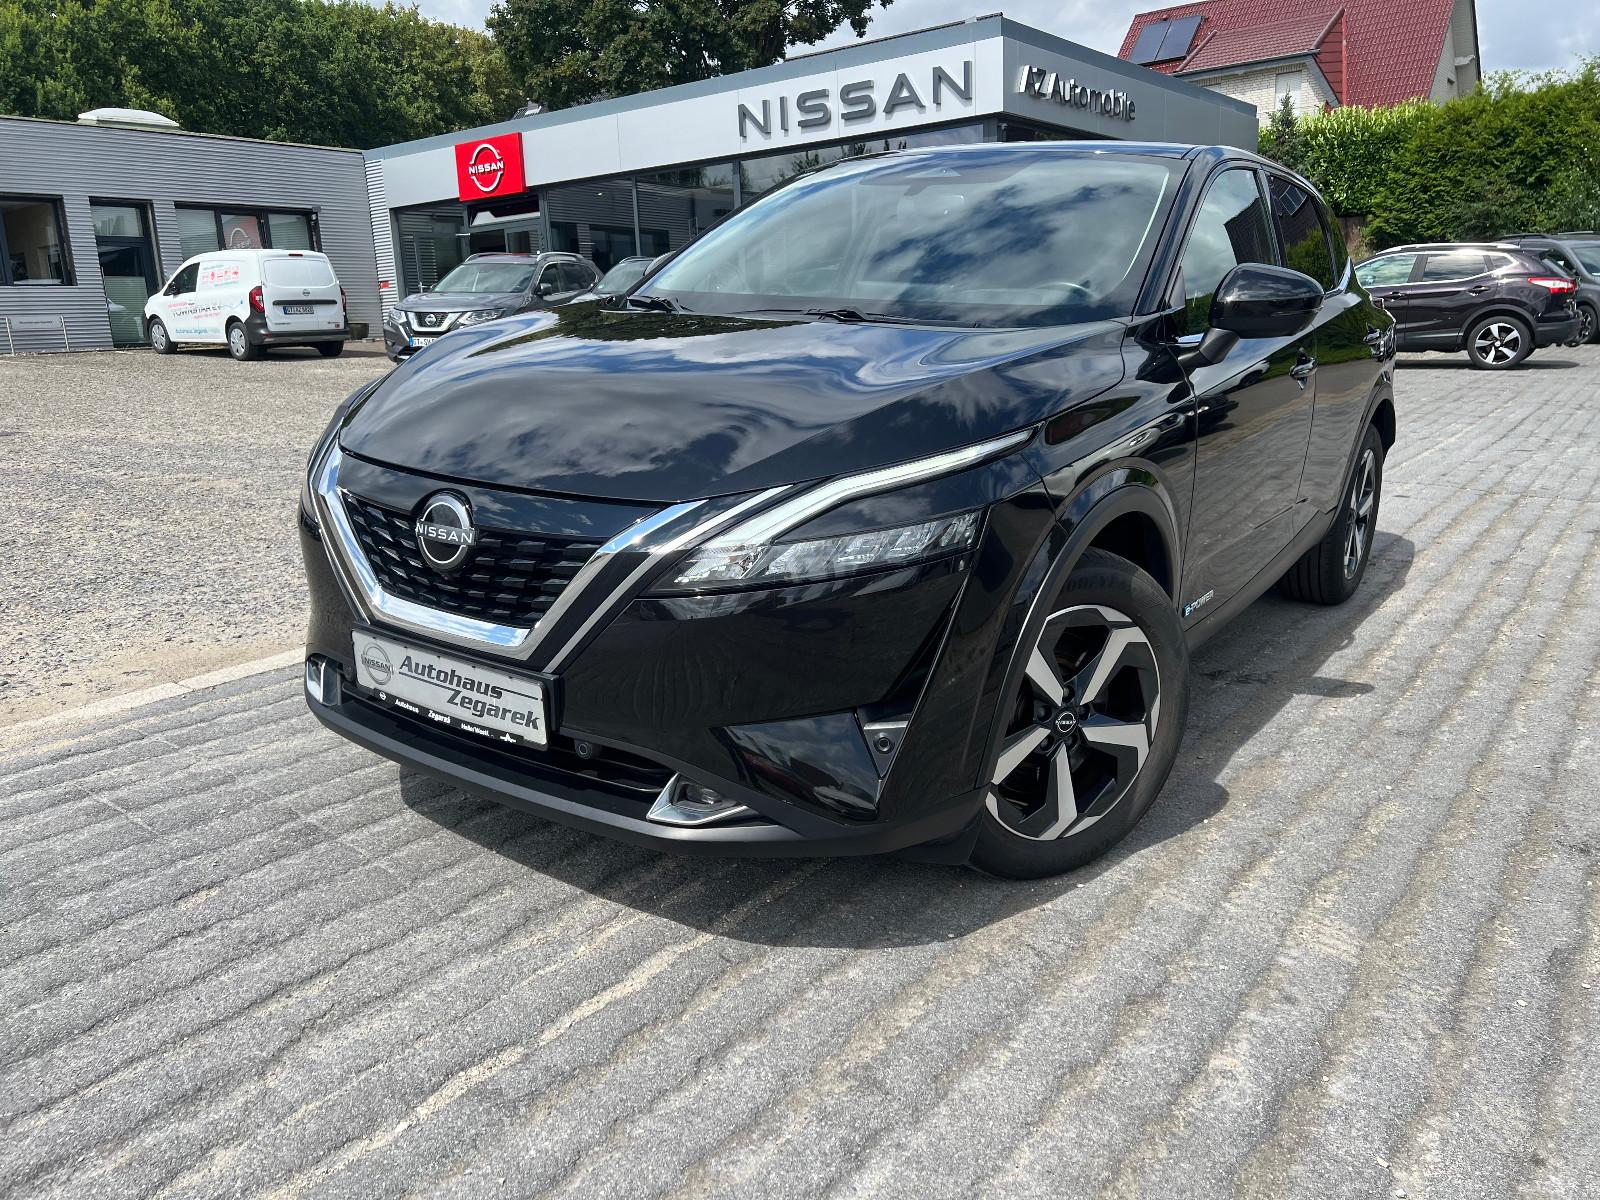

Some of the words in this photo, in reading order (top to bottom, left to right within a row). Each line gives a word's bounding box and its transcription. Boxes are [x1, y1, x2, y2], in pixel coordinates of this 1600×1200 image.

[738, 59, 973, 138] NISSAN
[1046, 72, 1136, 121] Automobile
[468, 161, 504, 174] NISSAN
[416, 522, 473, 544] NISSAN
[364, 656, 391, 672] NISSAN
[399, 655, 503, 700] Autohaus
[394, 699, 419, 714] Autohaus
[427, 710, 451, 724] Zegarek
[446, 689, 540, 731] Zegarek
